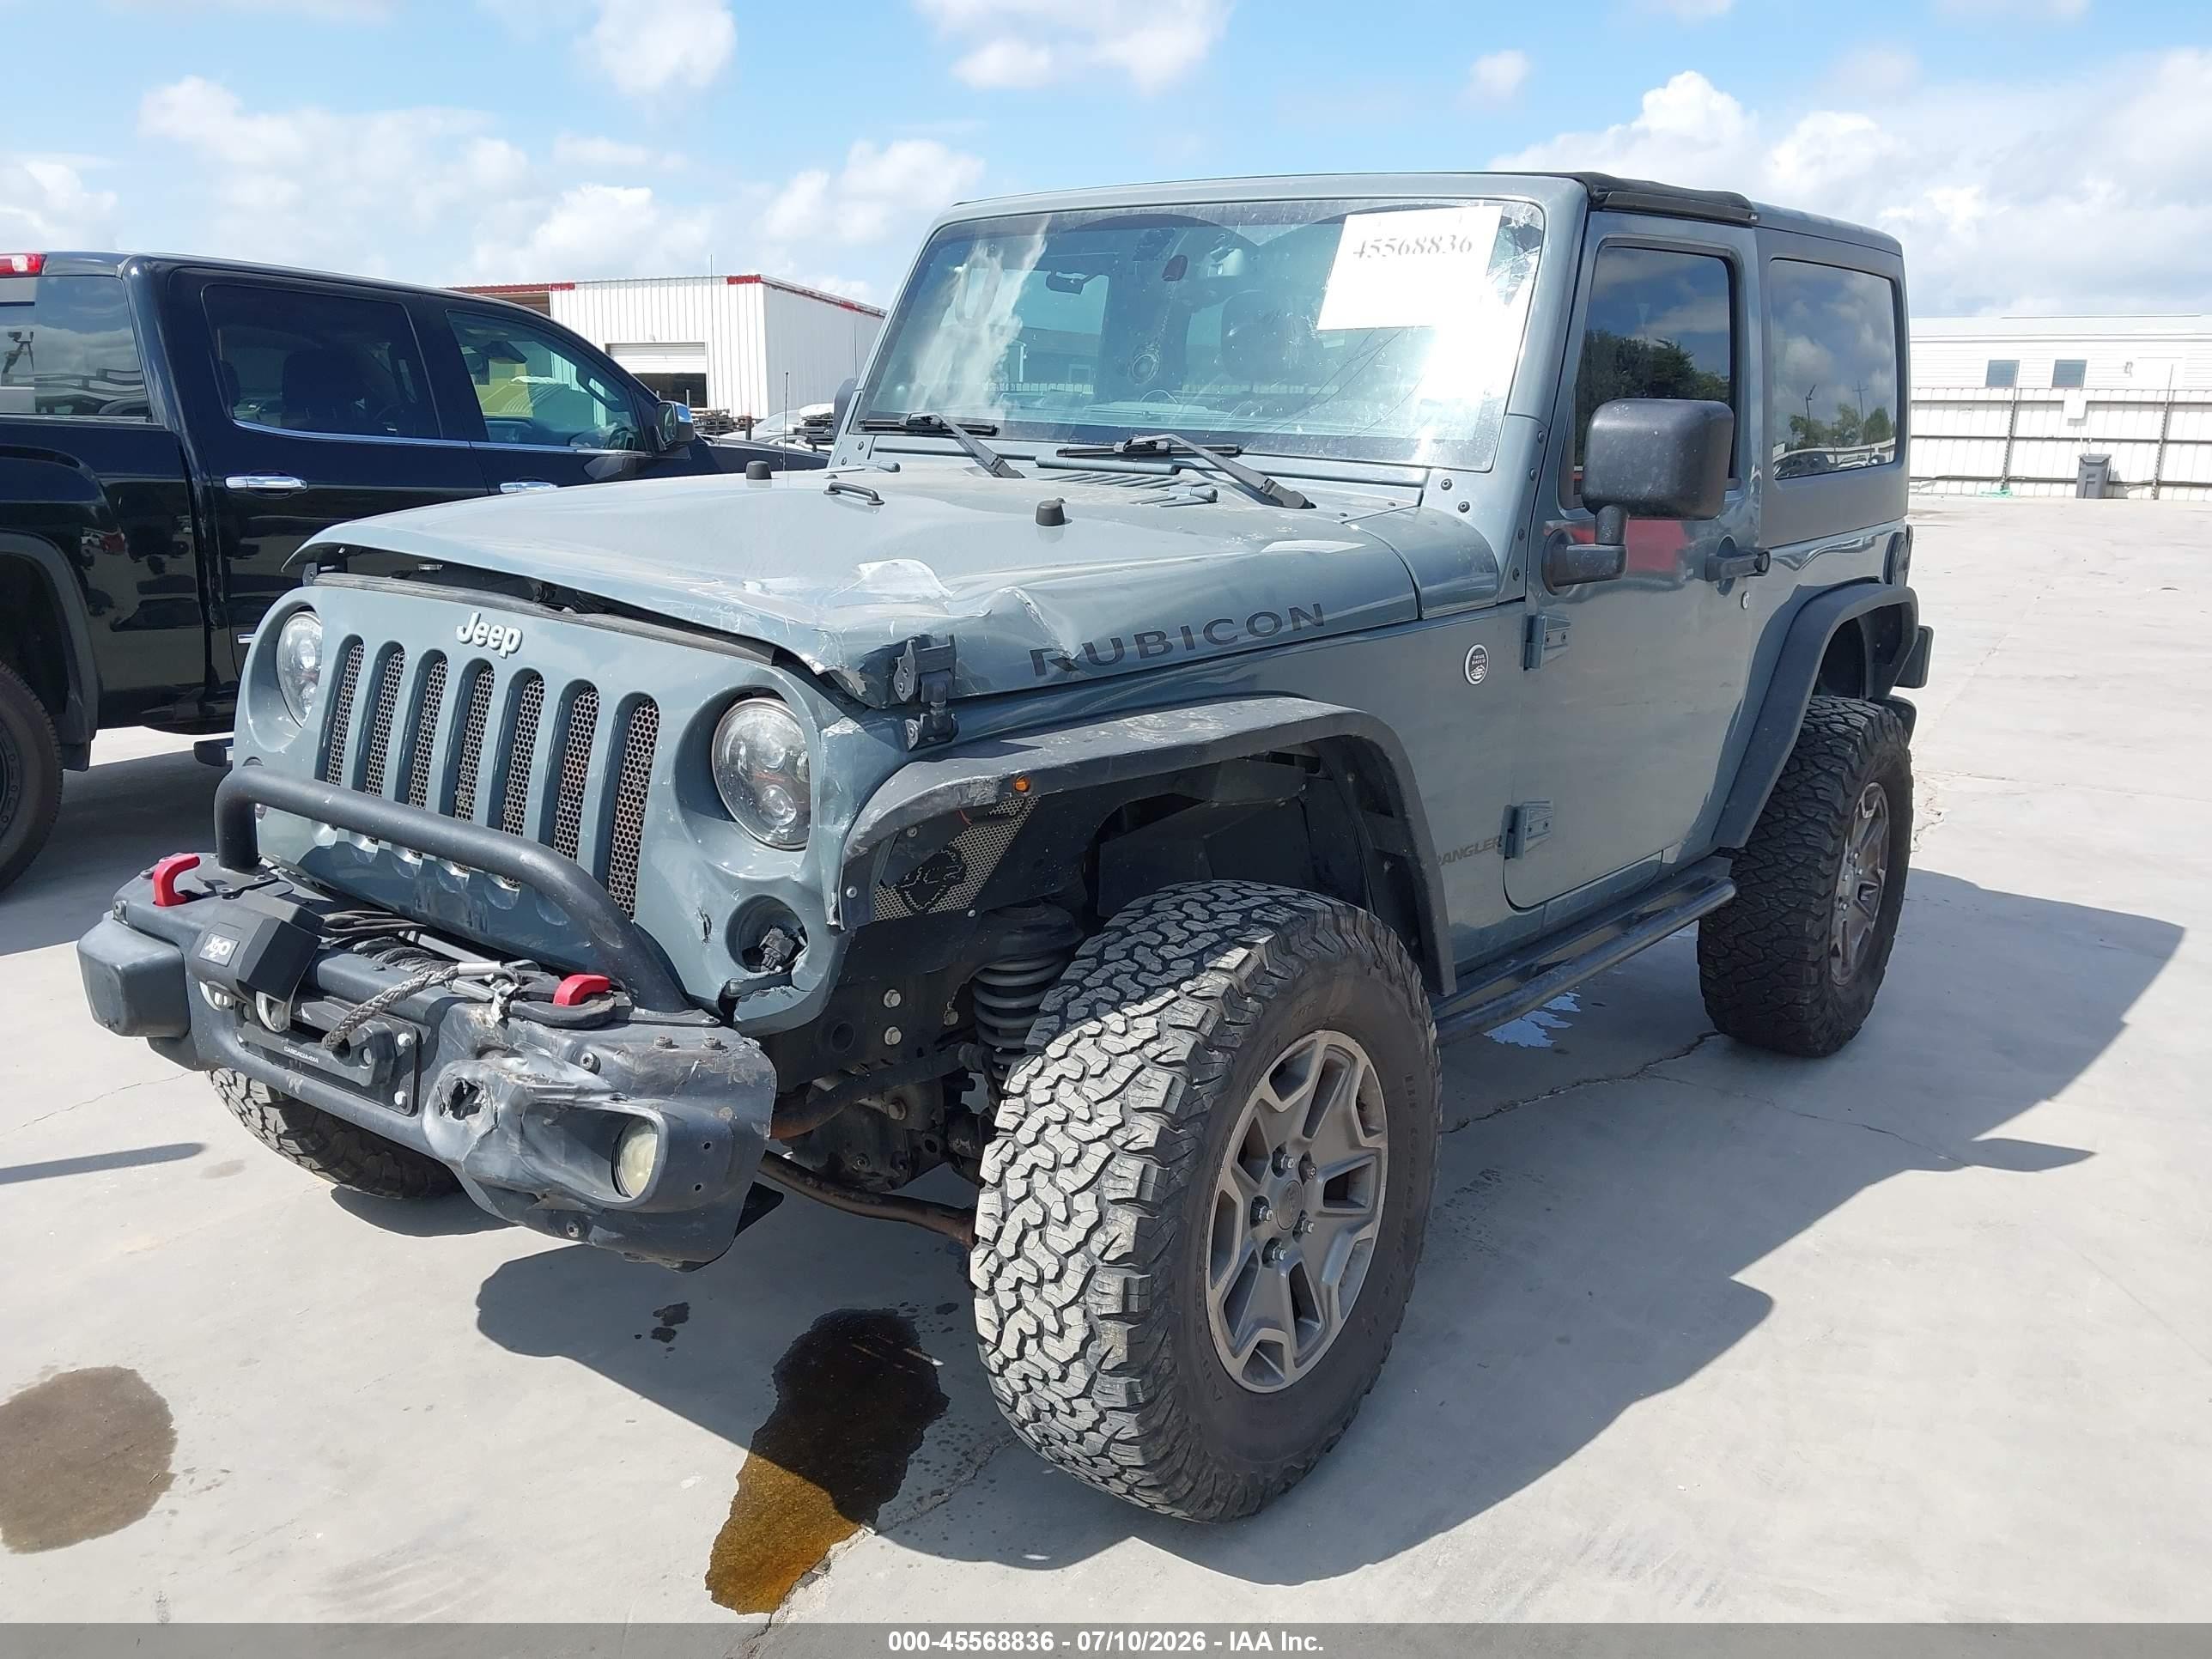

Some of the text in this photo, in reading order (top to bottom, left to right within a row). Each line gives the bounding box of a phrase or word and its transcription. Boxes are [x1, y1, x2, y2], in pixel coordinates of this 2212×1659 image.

[1353, 234, 1474, 259] 45568836
[456, 611, 523, 659] Jeep
[1030, 603, 1324, 677] RUBICON
